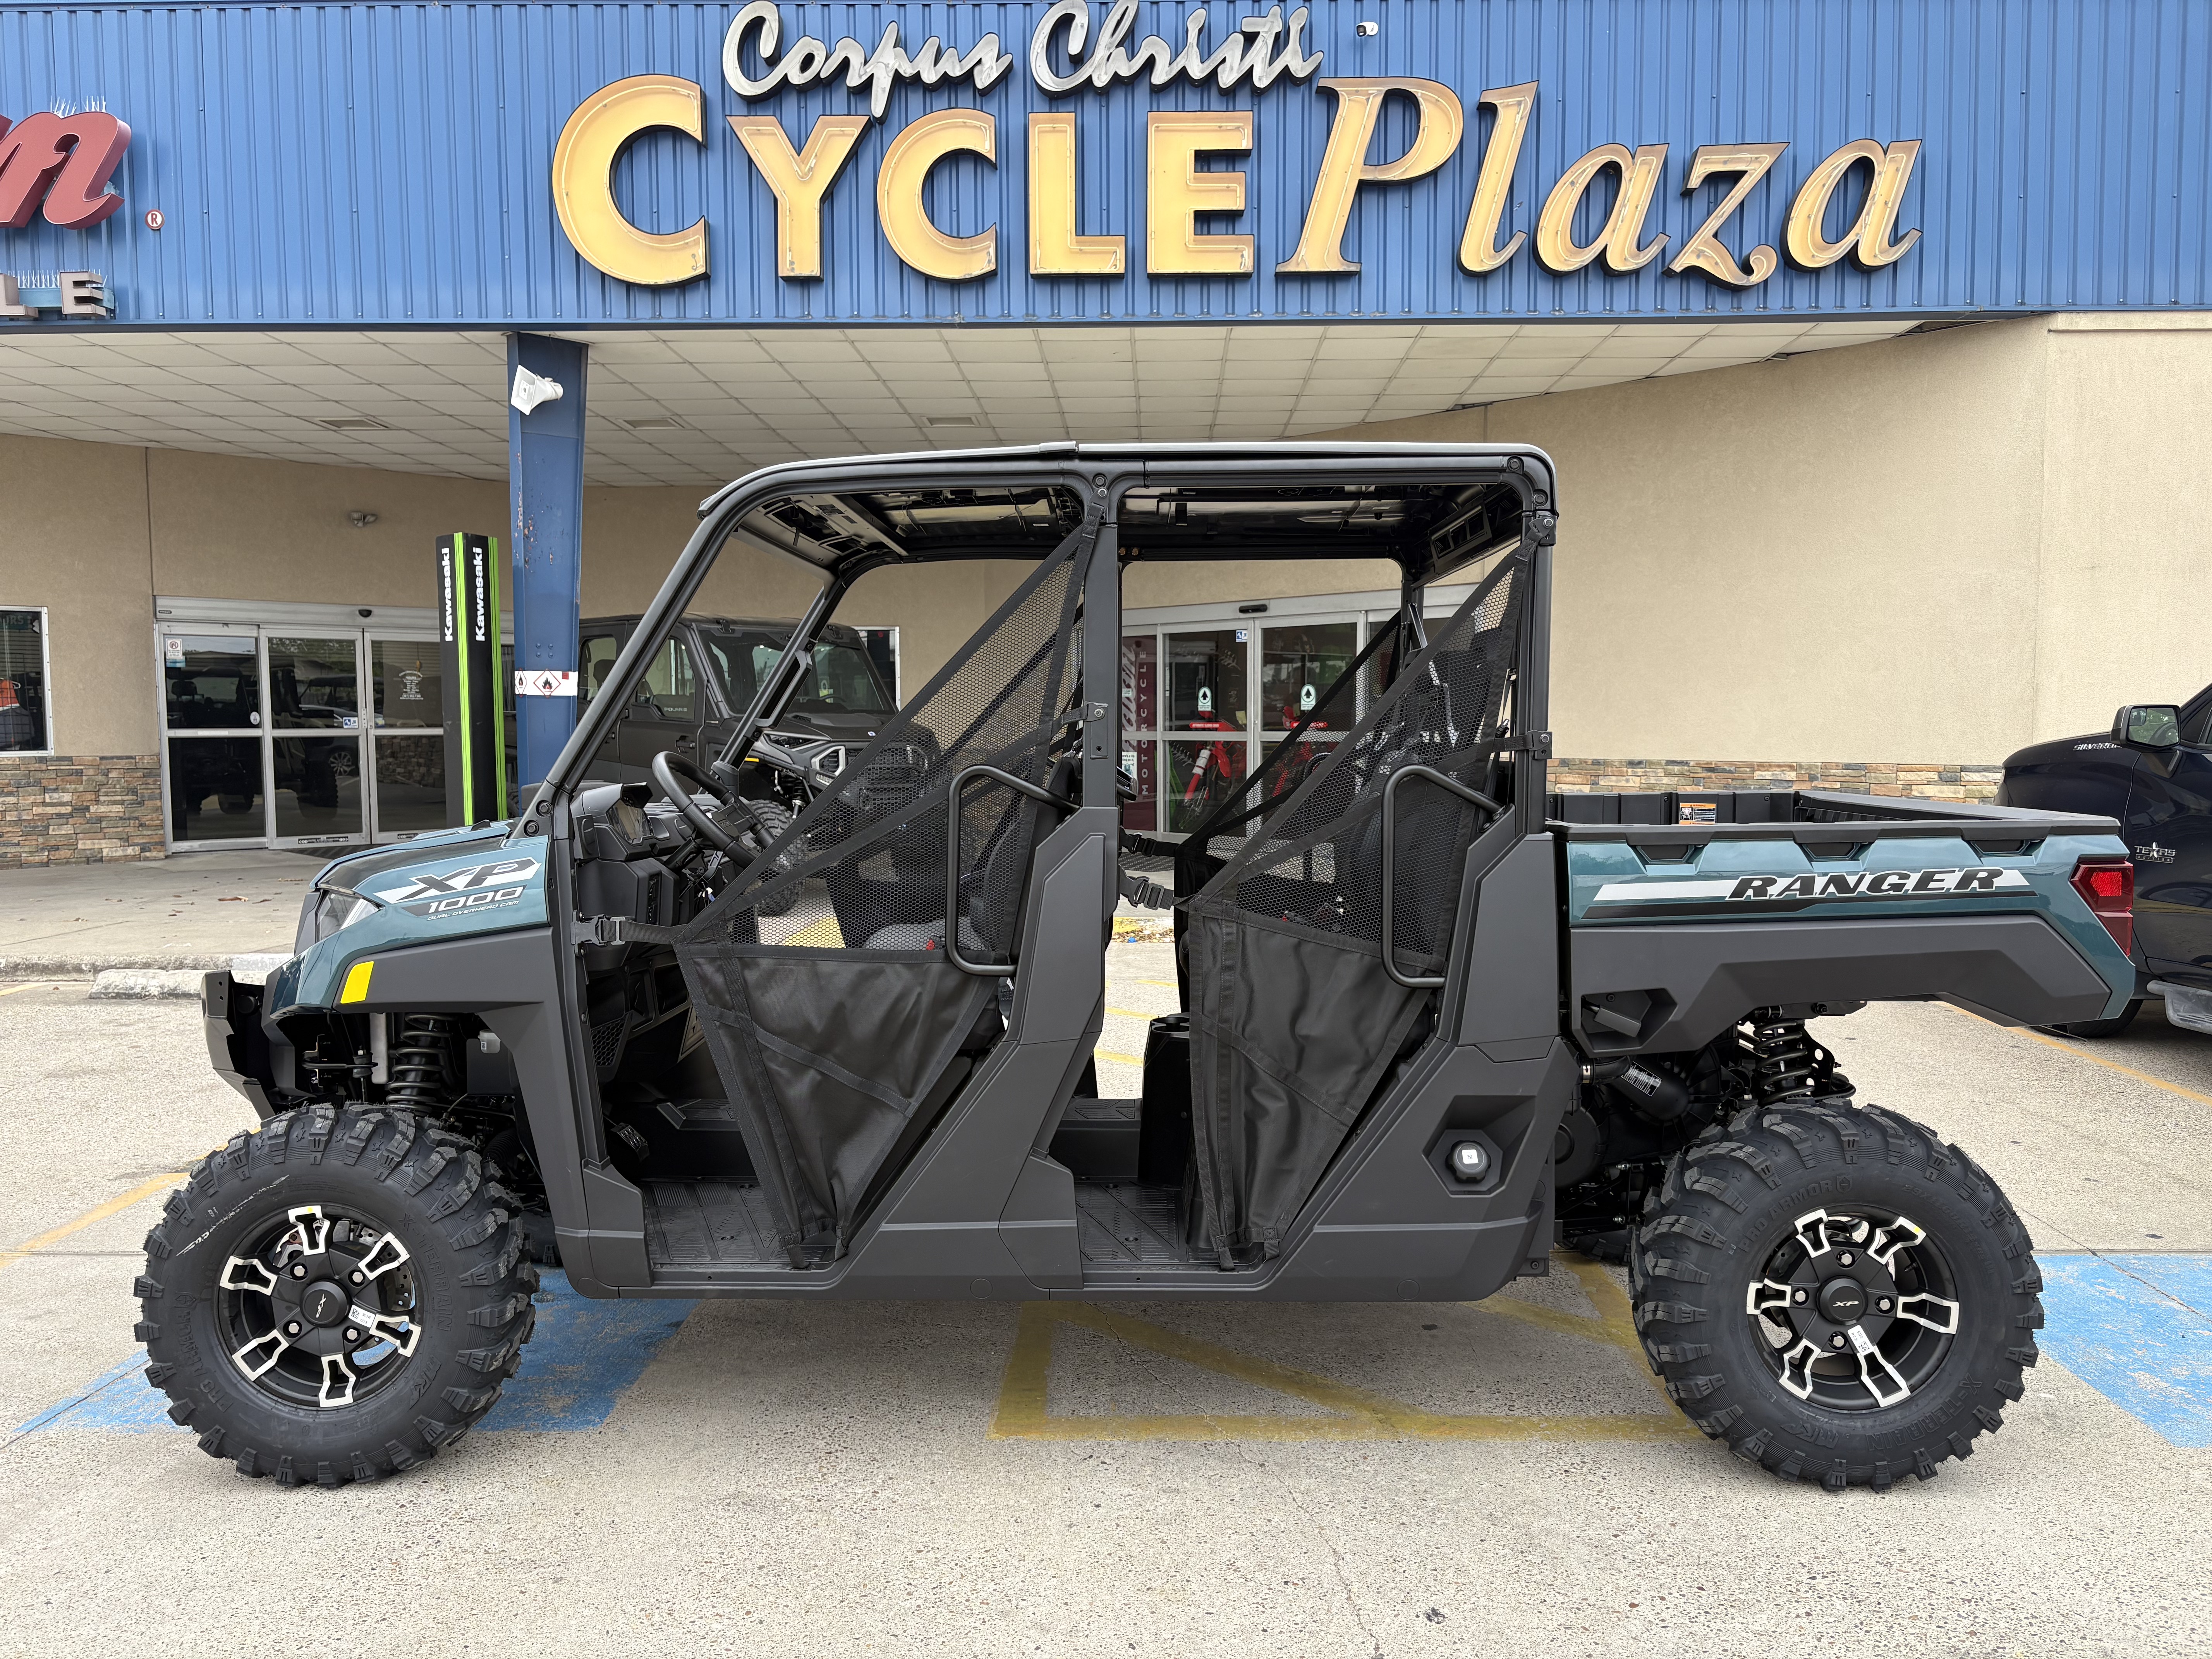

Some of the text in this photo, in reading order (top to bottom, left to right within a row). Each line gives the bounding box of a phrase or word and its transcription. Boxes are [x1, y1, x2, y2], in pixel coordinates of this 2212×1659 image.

[722, 0, 1324, 123] Corpus Christi
[551, 73, 1924, 290] CYCLE Plaza
[441, 548, 453, 641] Kawasaki
[473, 547, 485, 641] Kawasaki
[1140, 651, 1148, 795] MOTORCYCLE
[394, 857, 536, 902] XP
[428, 886, 524, 913] 1000
[452, 905, 498, 916] OVERHEAD
[1726, 867, 2004, 901] RANGER
[316, 1293, 326, 1318] XP
[398, 1211, 452, 1332] X-TERRAIN
[1869, 1372, 1984, 1451] X-TERRAIN
